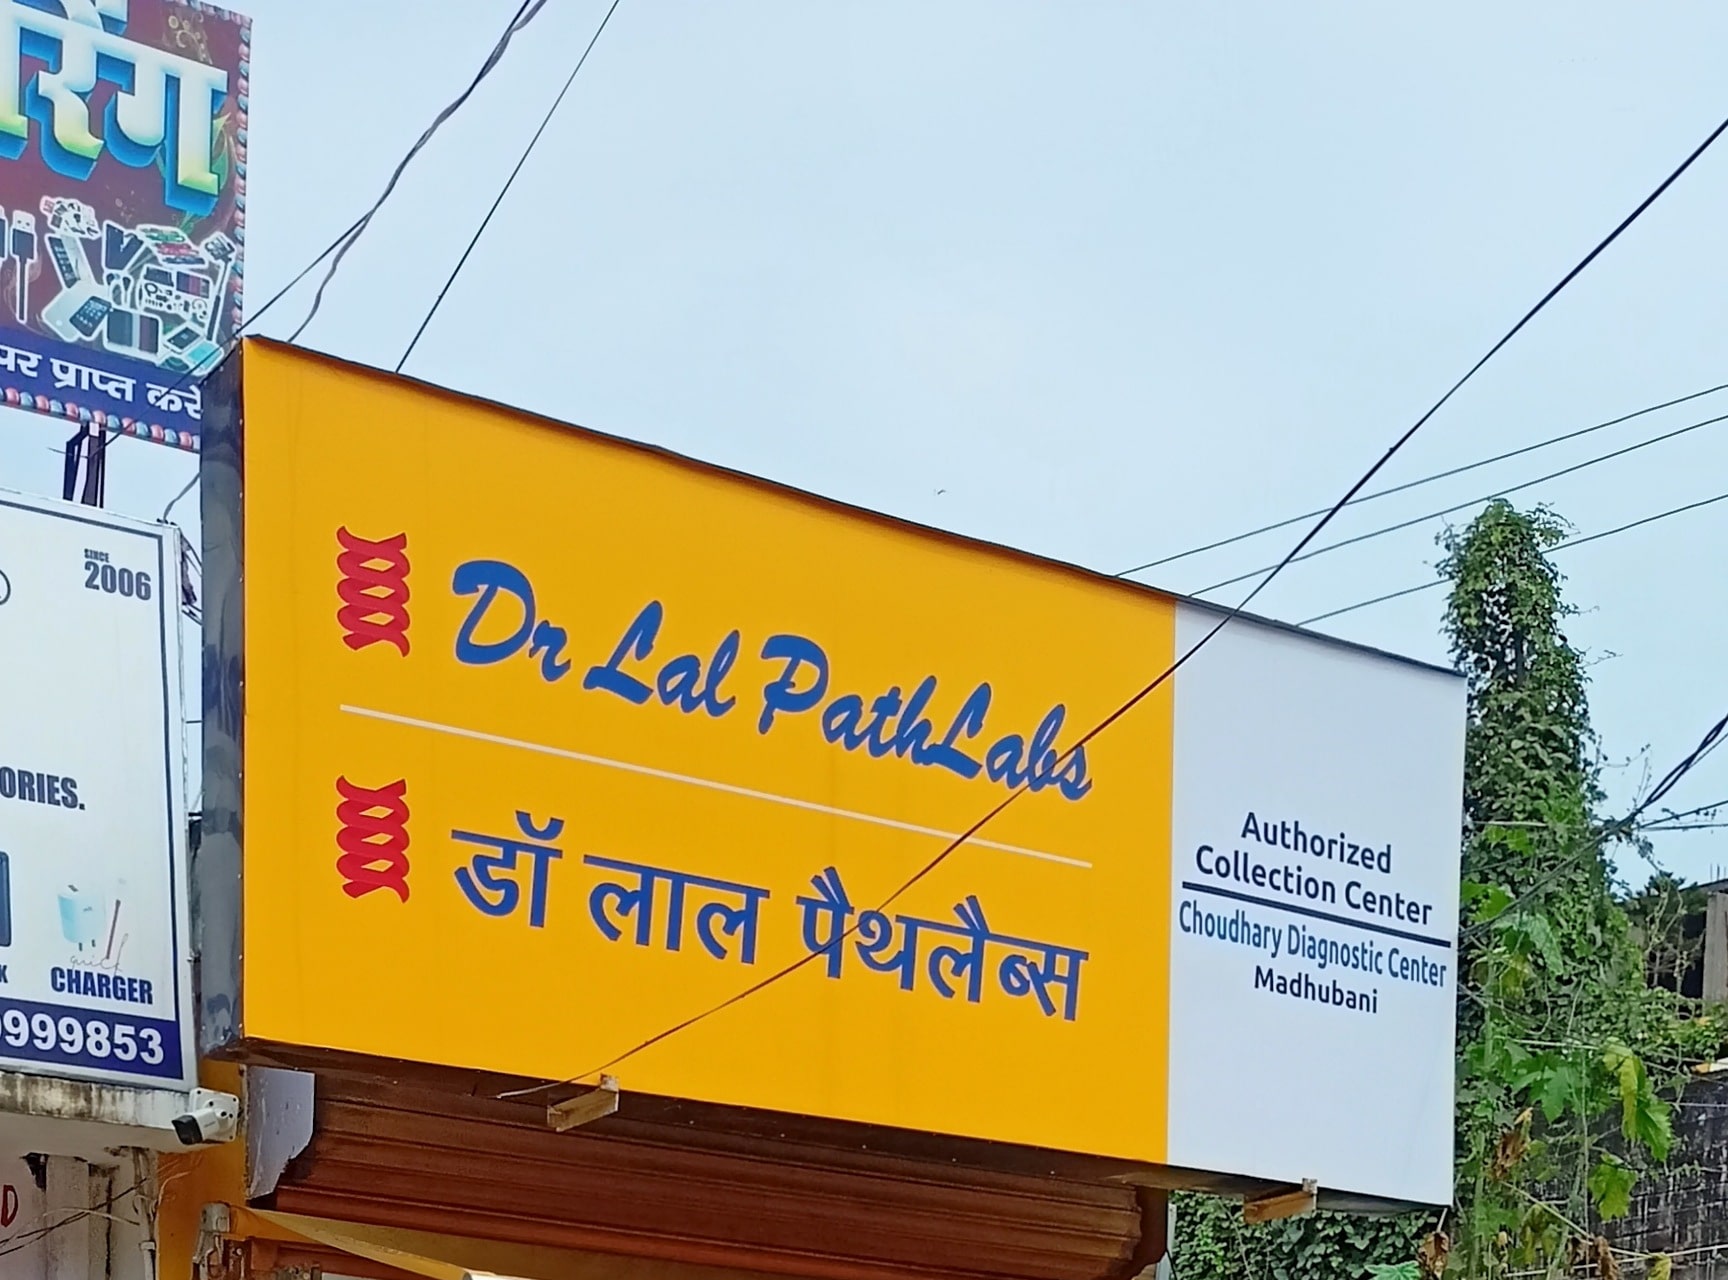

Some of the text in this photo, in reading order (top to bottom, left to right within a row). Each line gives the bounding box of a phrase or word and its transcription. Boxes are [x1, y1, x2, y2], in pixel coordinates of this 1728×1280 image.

[50, 357, 136, 403] प्राप्त
[84, 548, 110, 563] SINCE
[84, 560, 152, 601] 2006
[452, 559, 1093, 801] Dr Lal PathLabs
[1241, 811, 1392, 874] Authorized
[1195, 844, 1433, 925] Collection Center
[451, 810, 1090, 1022] डॉ लाल पैथलैब्स
[1179, 900, 1447, 988] Choudhary Diagnostic Center
[50, 966, 153, 1005] CHARGER
[1254, 965, 1379, 1014] Madhubani
[0, 1009, 164, 1065] 999853
